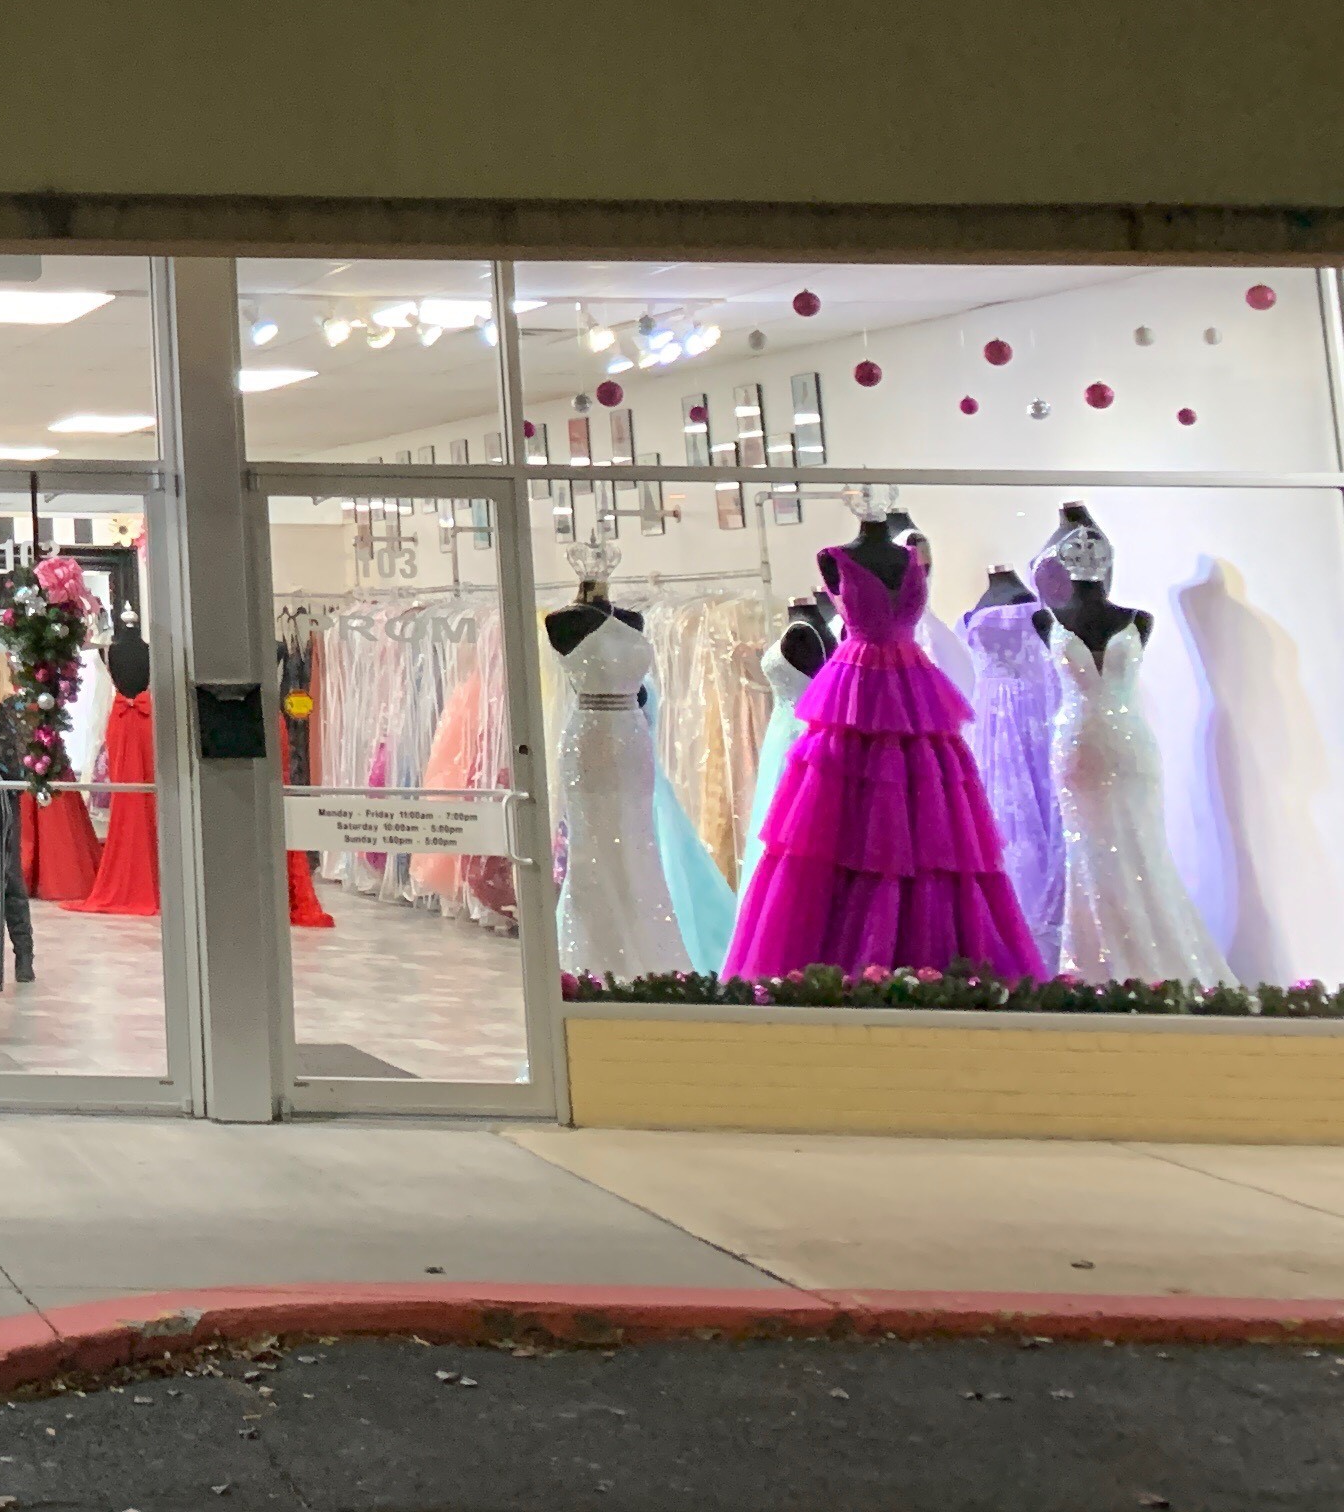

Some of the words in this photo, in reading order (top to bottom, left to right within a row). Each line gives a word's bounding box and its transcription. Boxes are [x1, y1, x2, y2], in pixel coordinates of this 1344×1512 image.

[358, 547, 418, 579] 103
[295, 612, 477, 644] PROM
[318, 808, 354, 820] Monday
[365, 809, 395, 821] Friday
[337, 821, 379, 833] Saturday
[344, 834, 378, 846] Sunday
